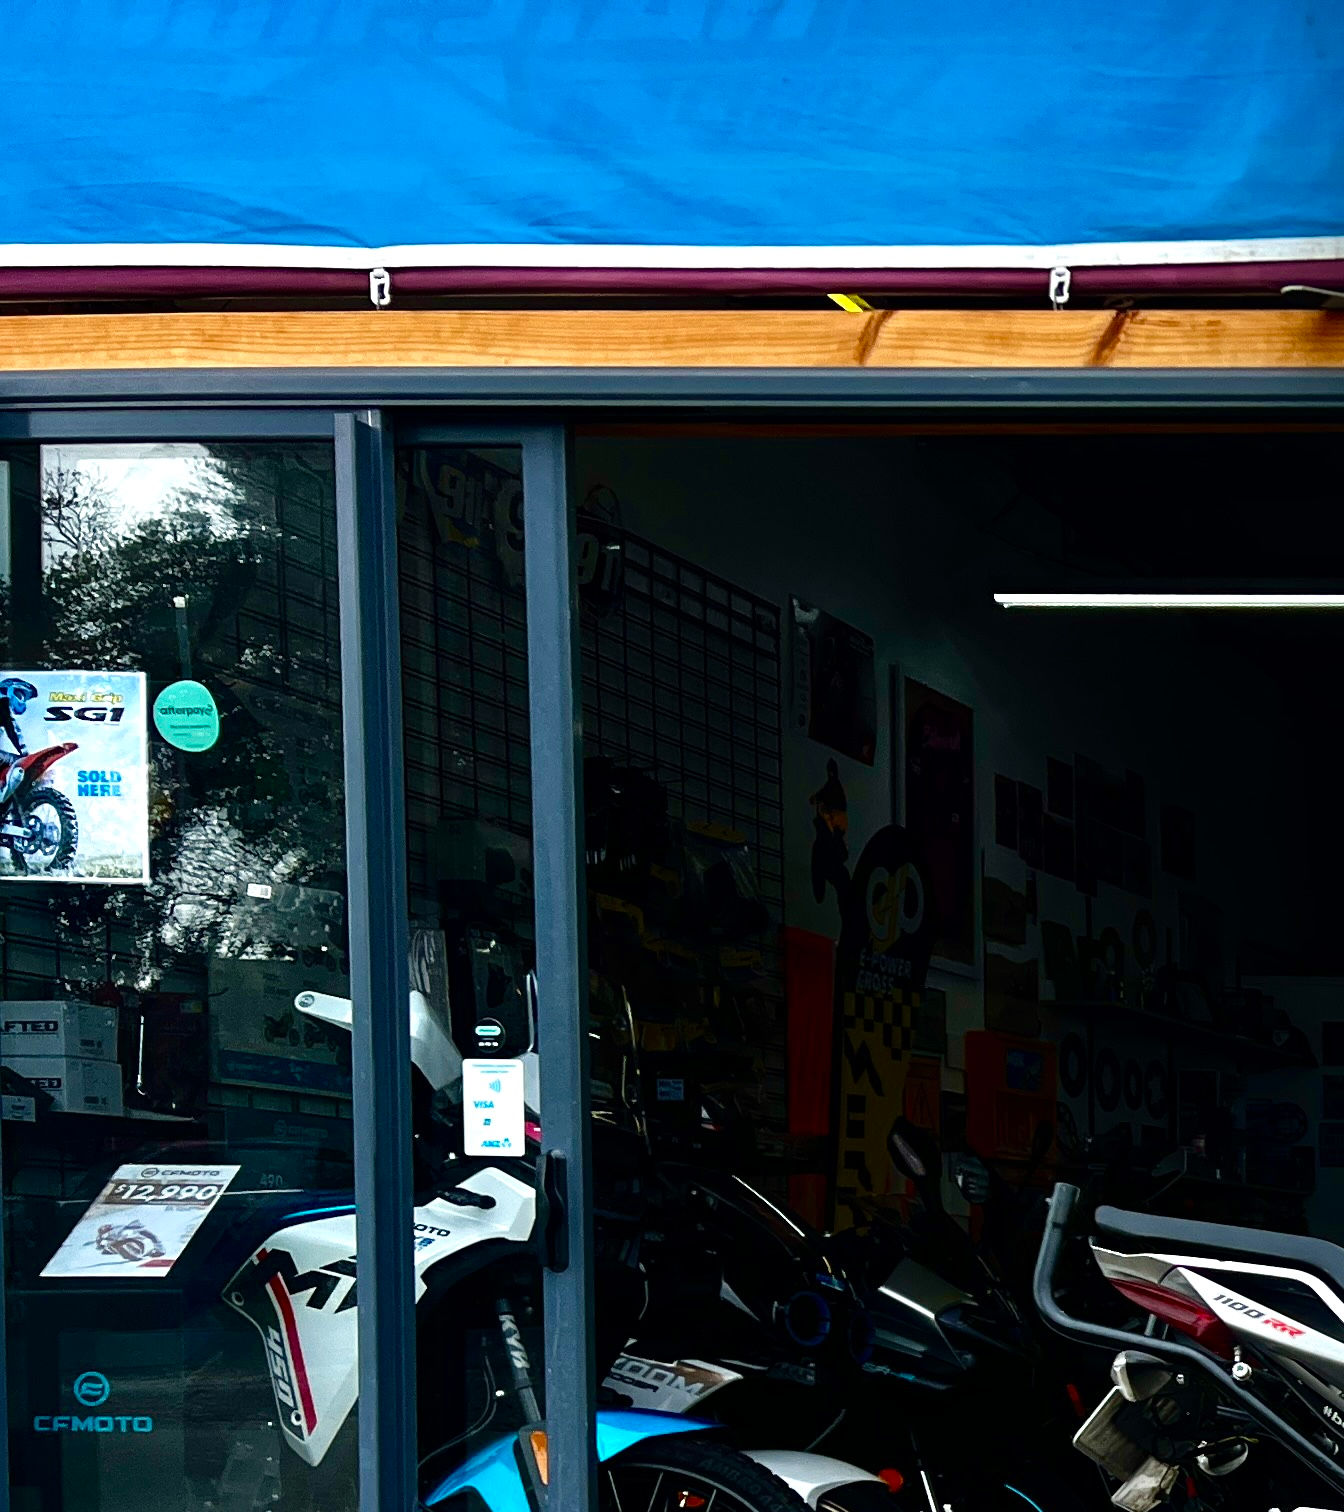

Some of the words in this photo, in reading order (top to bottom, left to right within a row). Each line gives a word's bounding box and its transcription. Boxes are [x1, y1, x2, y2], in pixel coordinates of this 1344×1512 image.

[43, 706, 125, 722] SG1
[77, 770, 122, 783] SOLD
[77, 784, 121, 797] HERE
[161, 1169, 220, 1177] CFMOTO
[114, 1184, 219, 1202] $12,990
[1213, 1294, 1265, 1319] 1100
[1262, 1317, 1306, 1338] RR
[34, 1415, 153, 1433] CFMOTO
